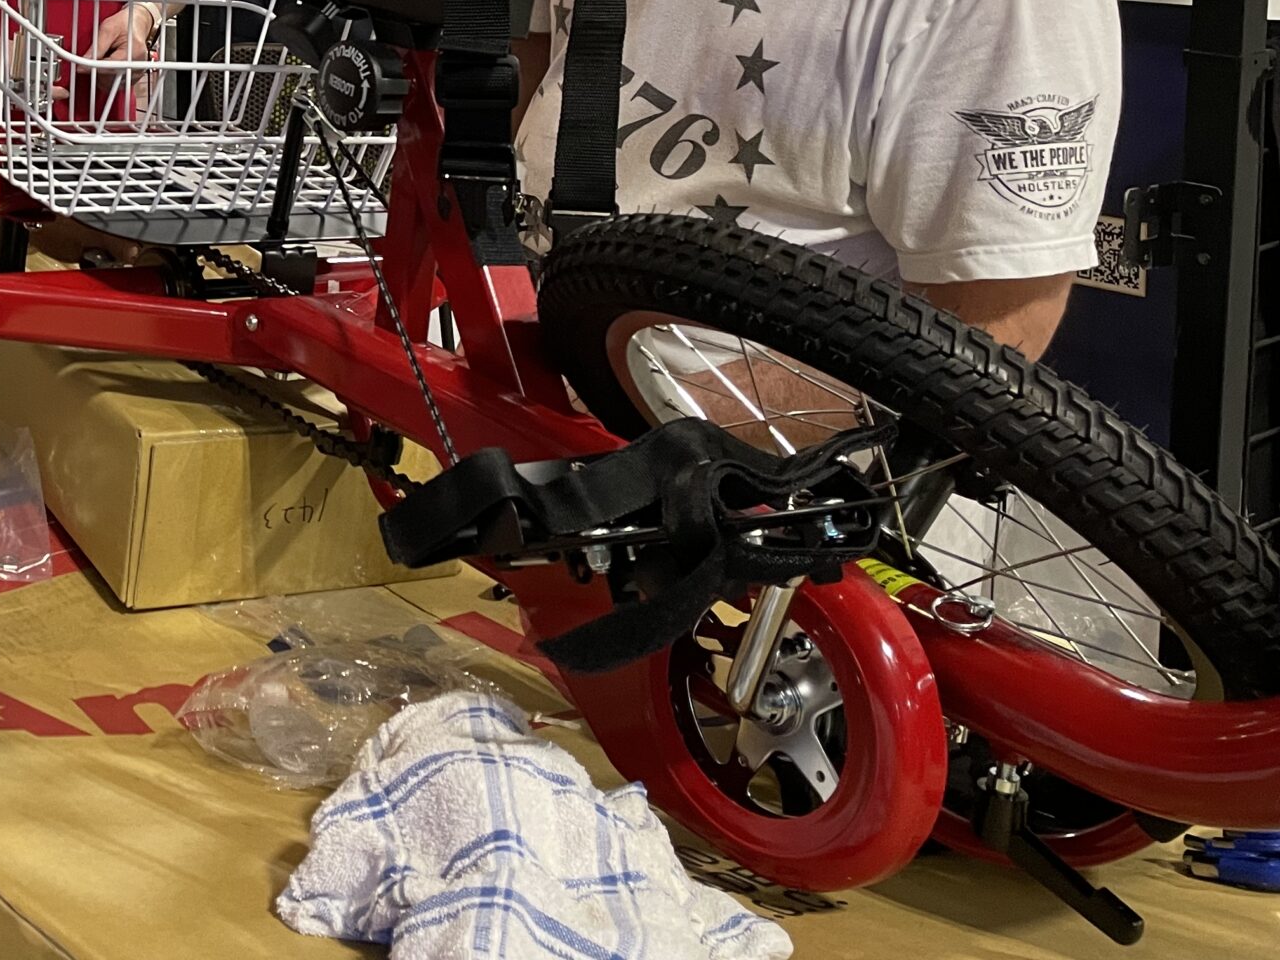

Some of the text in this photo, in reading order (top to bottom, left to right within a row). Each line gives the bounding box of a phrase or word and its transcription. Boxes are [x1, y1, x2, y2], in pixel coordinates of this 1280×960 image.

[328, 45, 371, 80] THEN PULL
[348, 107, 364, 124] TO
[618, 64, 720, 180] 76
[992, 146, 1085, 171] WE THE PEOPLE
[1017, 180, 1077, 192] HOLSTERS
